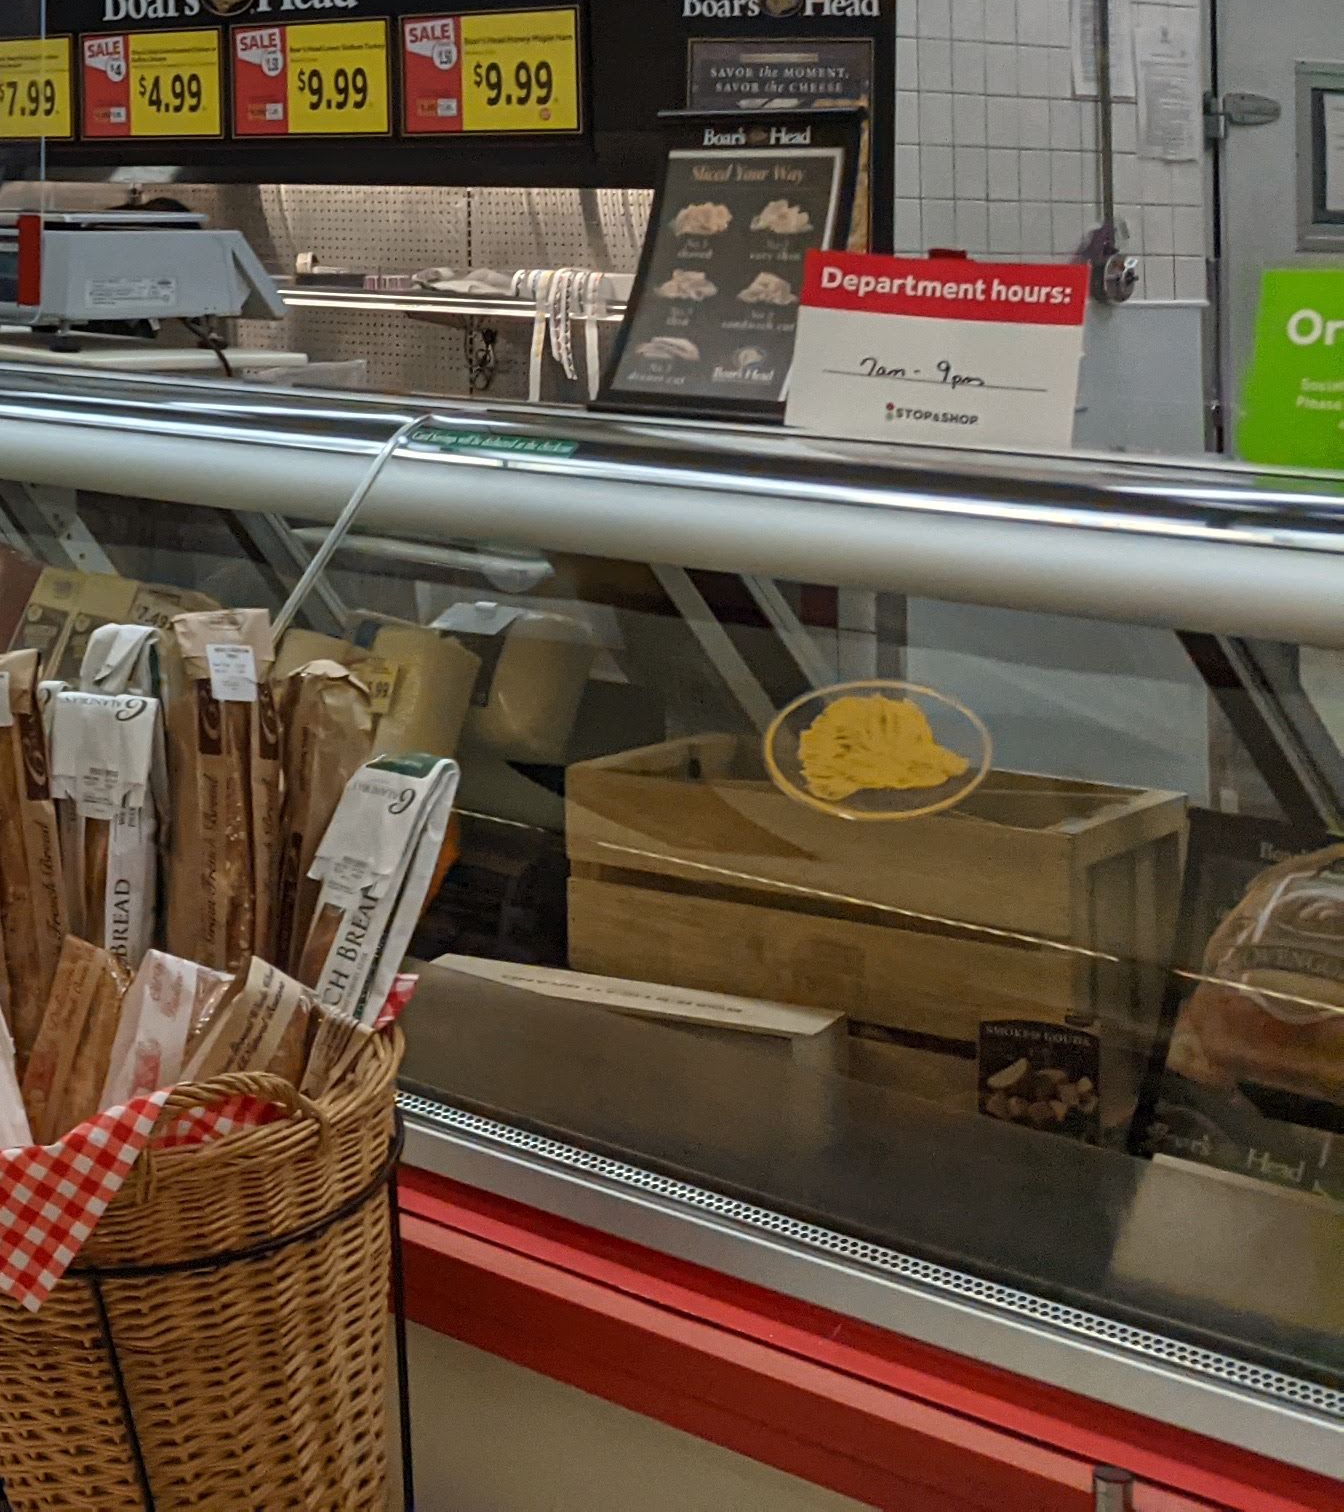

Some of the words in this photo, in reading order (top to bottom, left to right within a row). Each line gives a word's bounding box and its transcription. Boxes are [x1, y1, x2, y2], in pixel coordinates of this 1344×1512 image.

[240, 32, 277, 51] SALE
[409, 23, 451, 43] SALE
[87, 40, 120, 58] SALE
[711, 67, 755, 78] SAVOR
[759, 65, 778, 78] the
[138, 74, 202, 113] $4.99
[298, 68, 367, 110] $9.99
[474, 61, 553, 106] $9.99
[715, 82, 760, 93] SAVOR
[764, 80, 785, 93] the
[703, 127, 746, 146] Boar's
[769, 125, 811, 145] Head
[692, 164, 732, 182] Sliced
[737, 166, 768, 181] Your
[774, 165, 806, 185] Way
[821, 267, 986, 300] Department
[991, 279, 1072, 304] hours:
[860, 357, 906, 377] 7am
[936, 360, 985, 389] 9pm
[108, 879, 131, 959] BREAD
